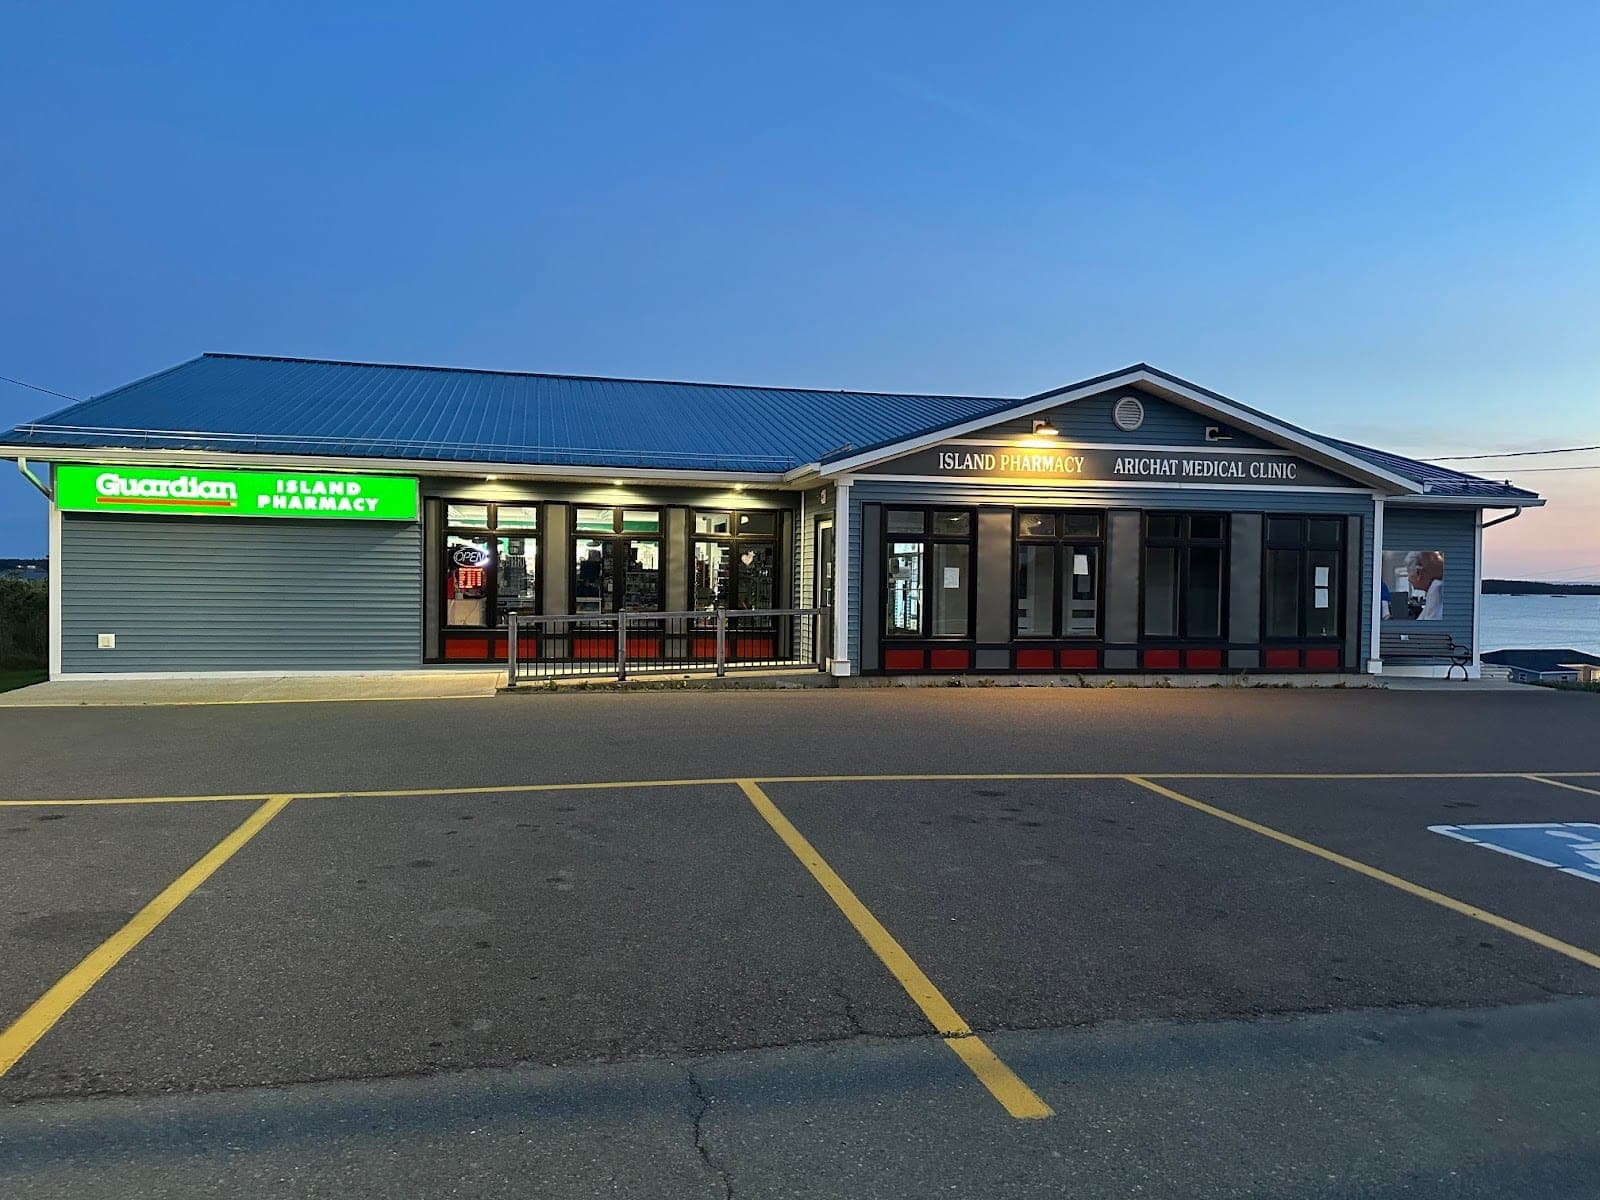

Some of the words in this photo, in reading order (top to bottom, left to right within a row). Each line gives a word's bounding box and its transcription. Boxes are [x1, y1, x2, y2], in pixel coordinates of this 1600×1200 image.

[938, 452, 995, 471] ISLAND
[1000, 454, 1085, 473] PHARMACY
[1113, 457, 1181, 476] ARICHAT
[1182, 460, 1246, 478] MEDICAL
[1249, 461, 1297, 479] CLINIC
[96, 473, 237, 500] Guardian
[276, 480, 362, 496] ISLAND
[257, 494, 379, 512] PHARMACY
[456, 551, 485, 563] OPEN
